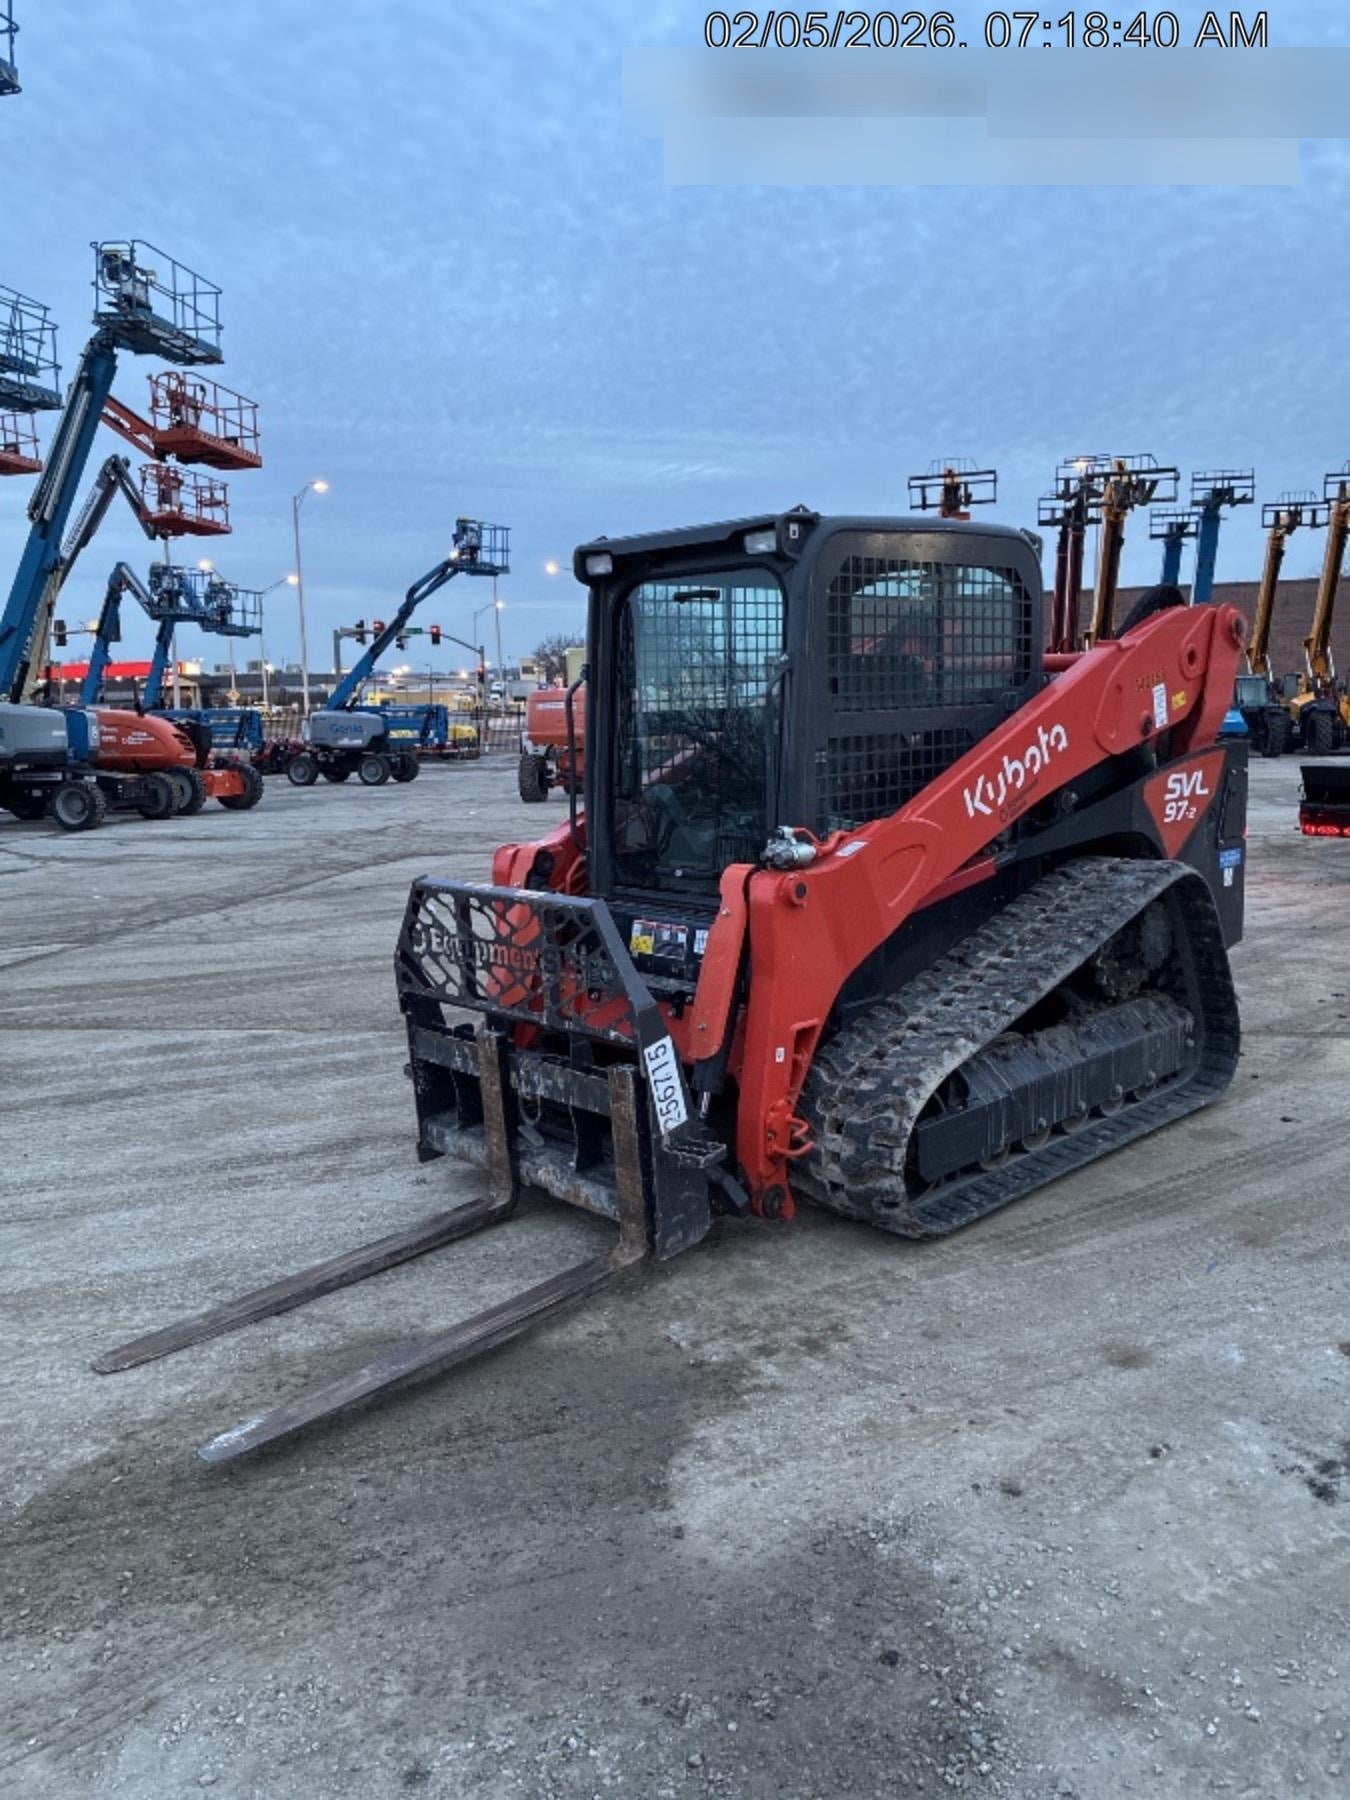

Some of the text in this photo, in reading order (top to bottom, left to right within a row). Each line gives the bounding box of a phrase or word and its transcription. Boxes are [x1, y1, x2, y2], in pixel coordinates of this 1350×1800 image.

[963, 723, 1069, 819] Kubota
[1164, 770, 1209, 801] SVL
[647, 1042, 682, 1132] 256715
